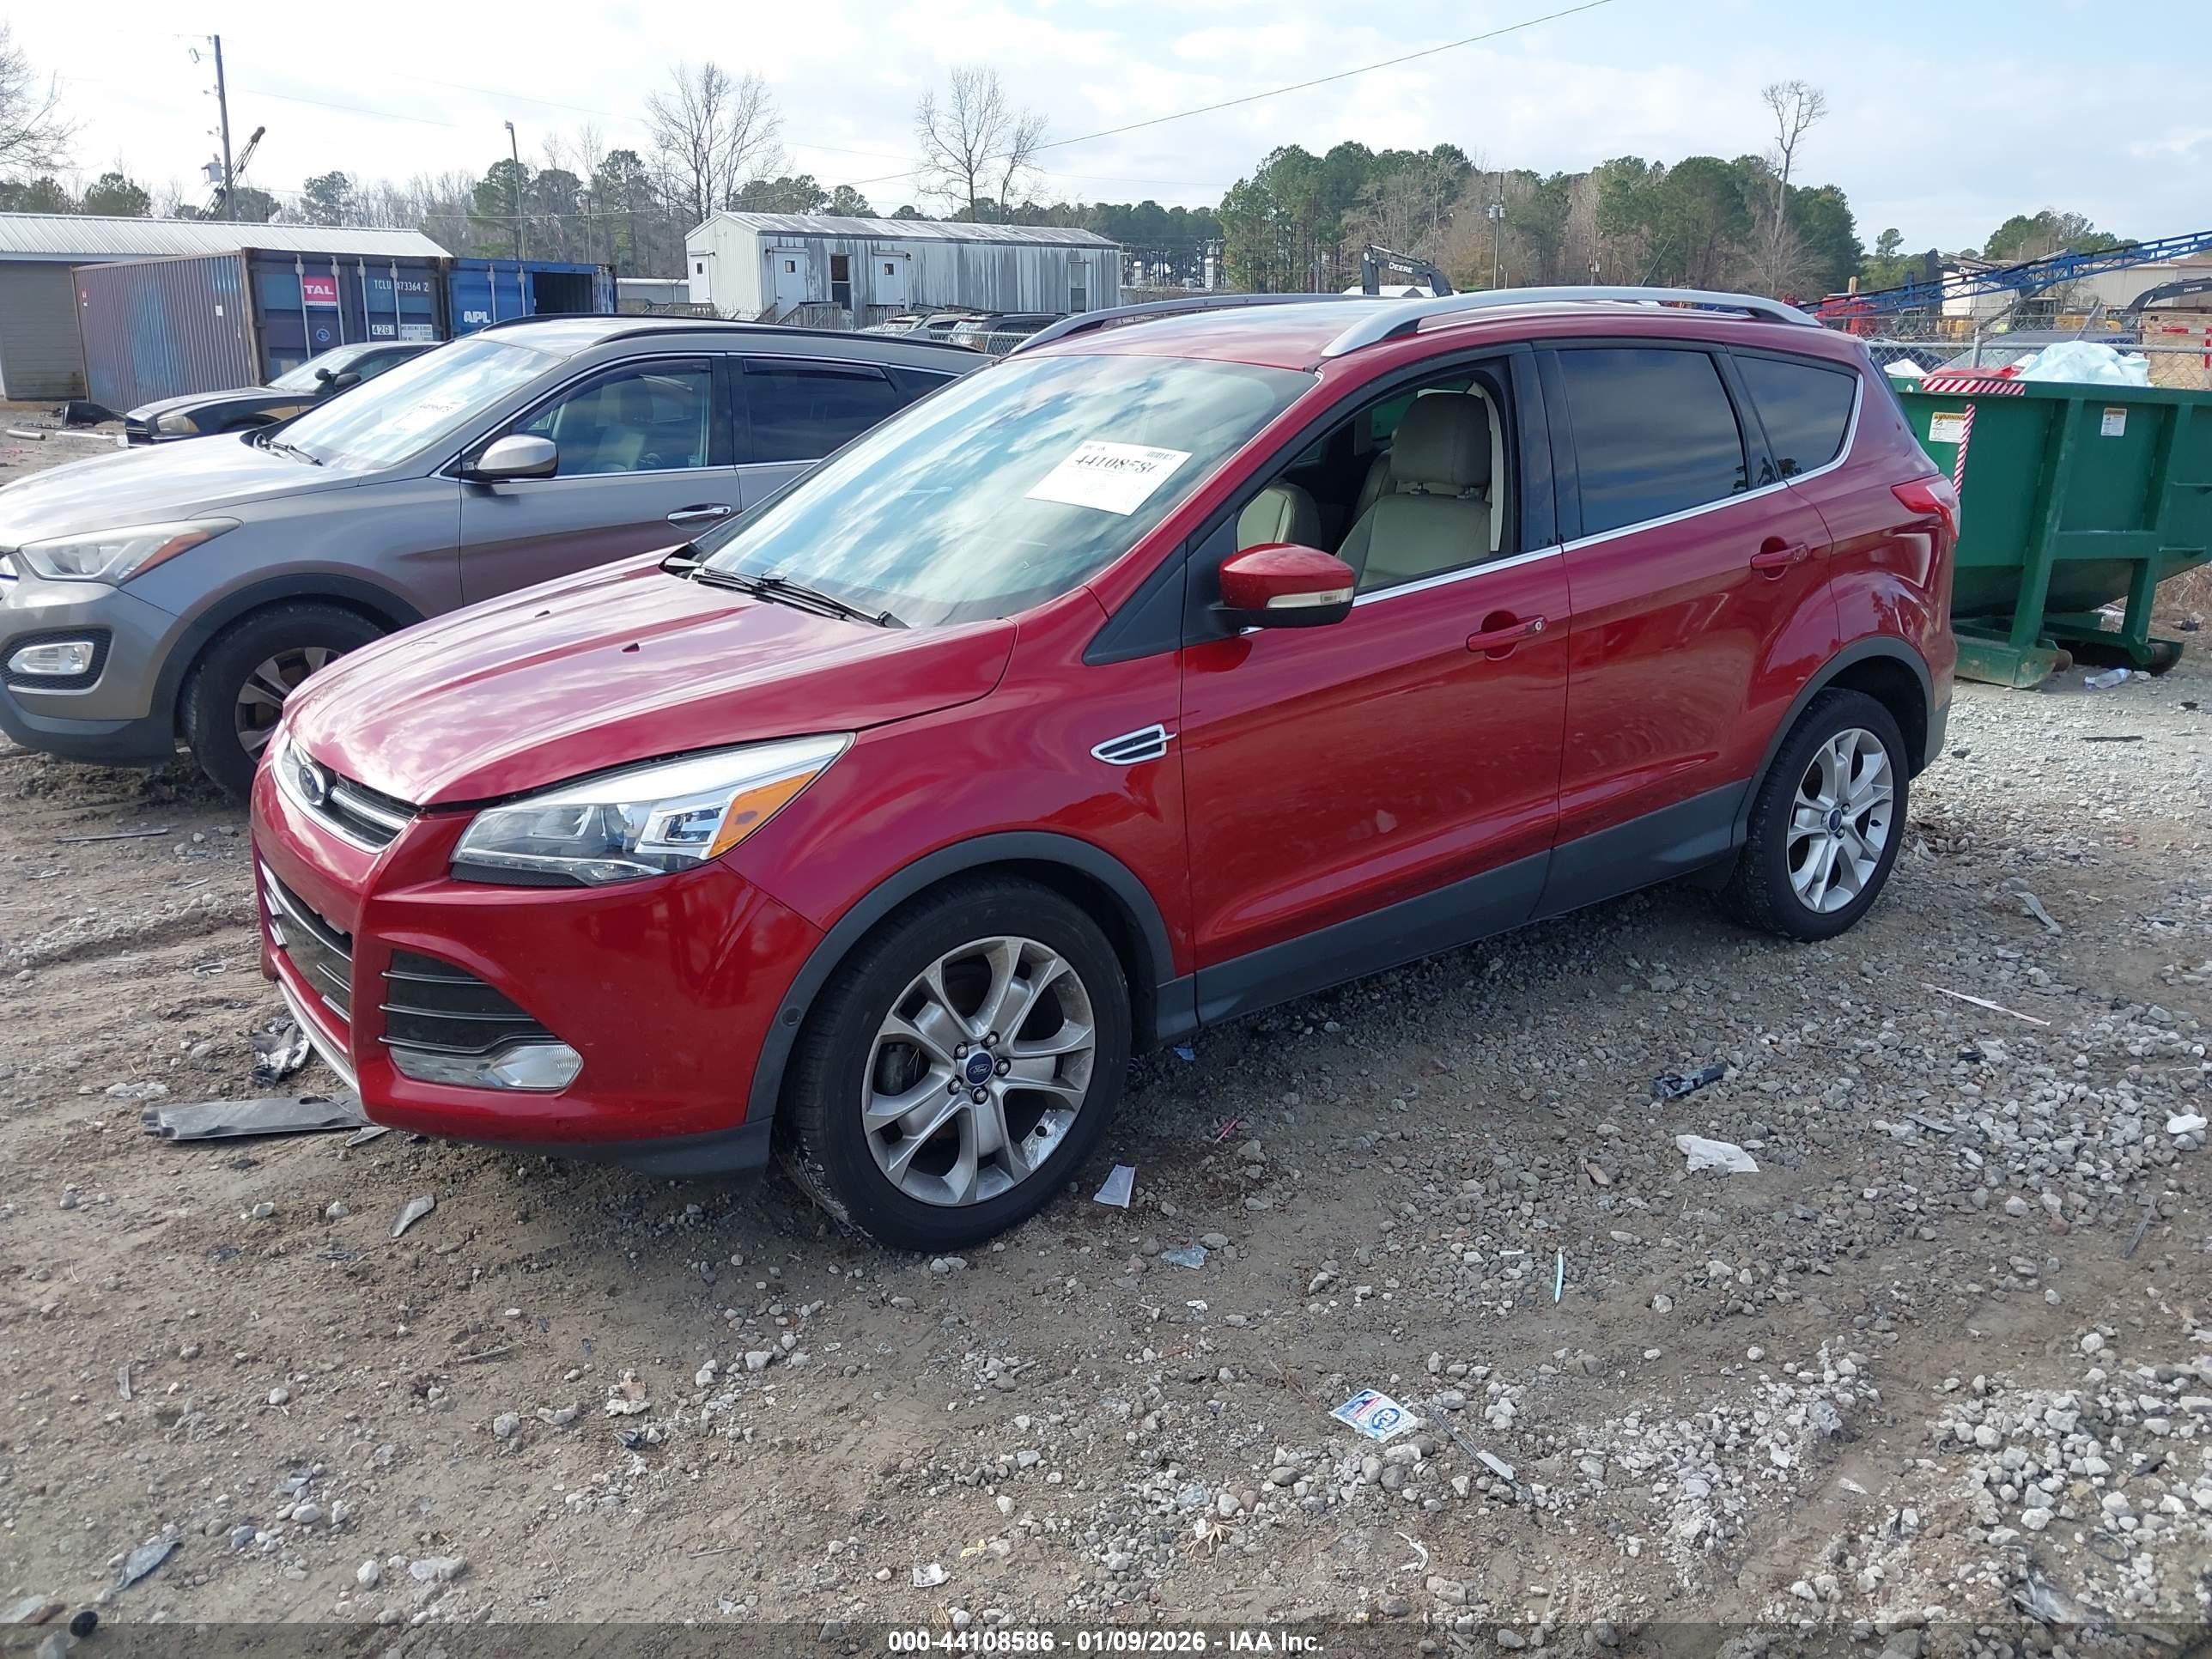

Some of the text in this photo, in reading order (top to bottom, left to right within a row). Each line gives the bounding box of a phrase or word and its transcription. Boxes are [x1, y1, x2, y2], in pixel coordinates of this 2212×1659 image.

[1389, 261, 1413, 274] DEERE
[304, 285, 334, 295] TAL
[464, 310, 491, 324] APL
